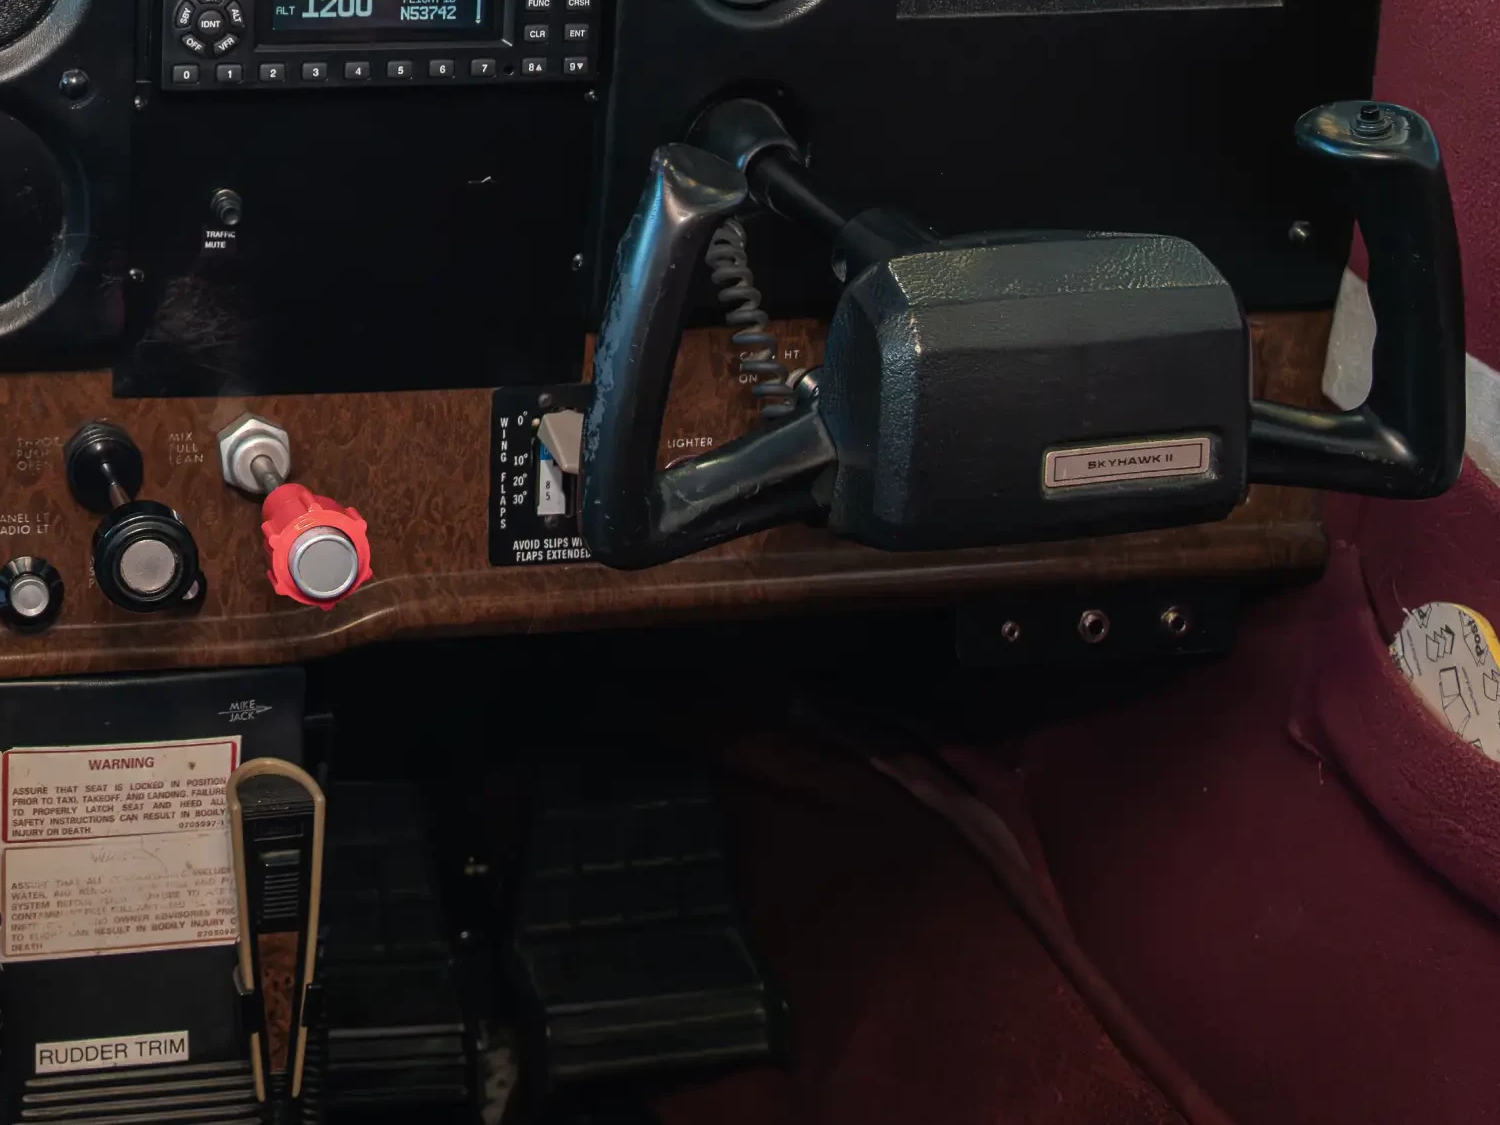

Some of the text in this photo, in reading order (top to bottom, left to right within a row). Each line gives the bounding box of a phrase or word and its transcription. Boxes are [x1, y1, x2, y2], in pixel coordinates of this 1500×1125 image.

[528, 0, 550, 7] FUNC
[401, 6, 456, 20] N53742
[201, 20, 220, 28] IDNT
[668, 437, 713, 448] LIGHTER
[1088, 454, 1173, 469] SKYHAWK II
[513, 538, 568, 550] AVOID SLIPS
[516, 550, 543, 561] FLAPS
[89, 757, 154, 771] WARNING
[12, 814, 115, 827] SAFETY INSTRUCTIONS
[39, 1038, 185, 1065] RUDDER TRIM
